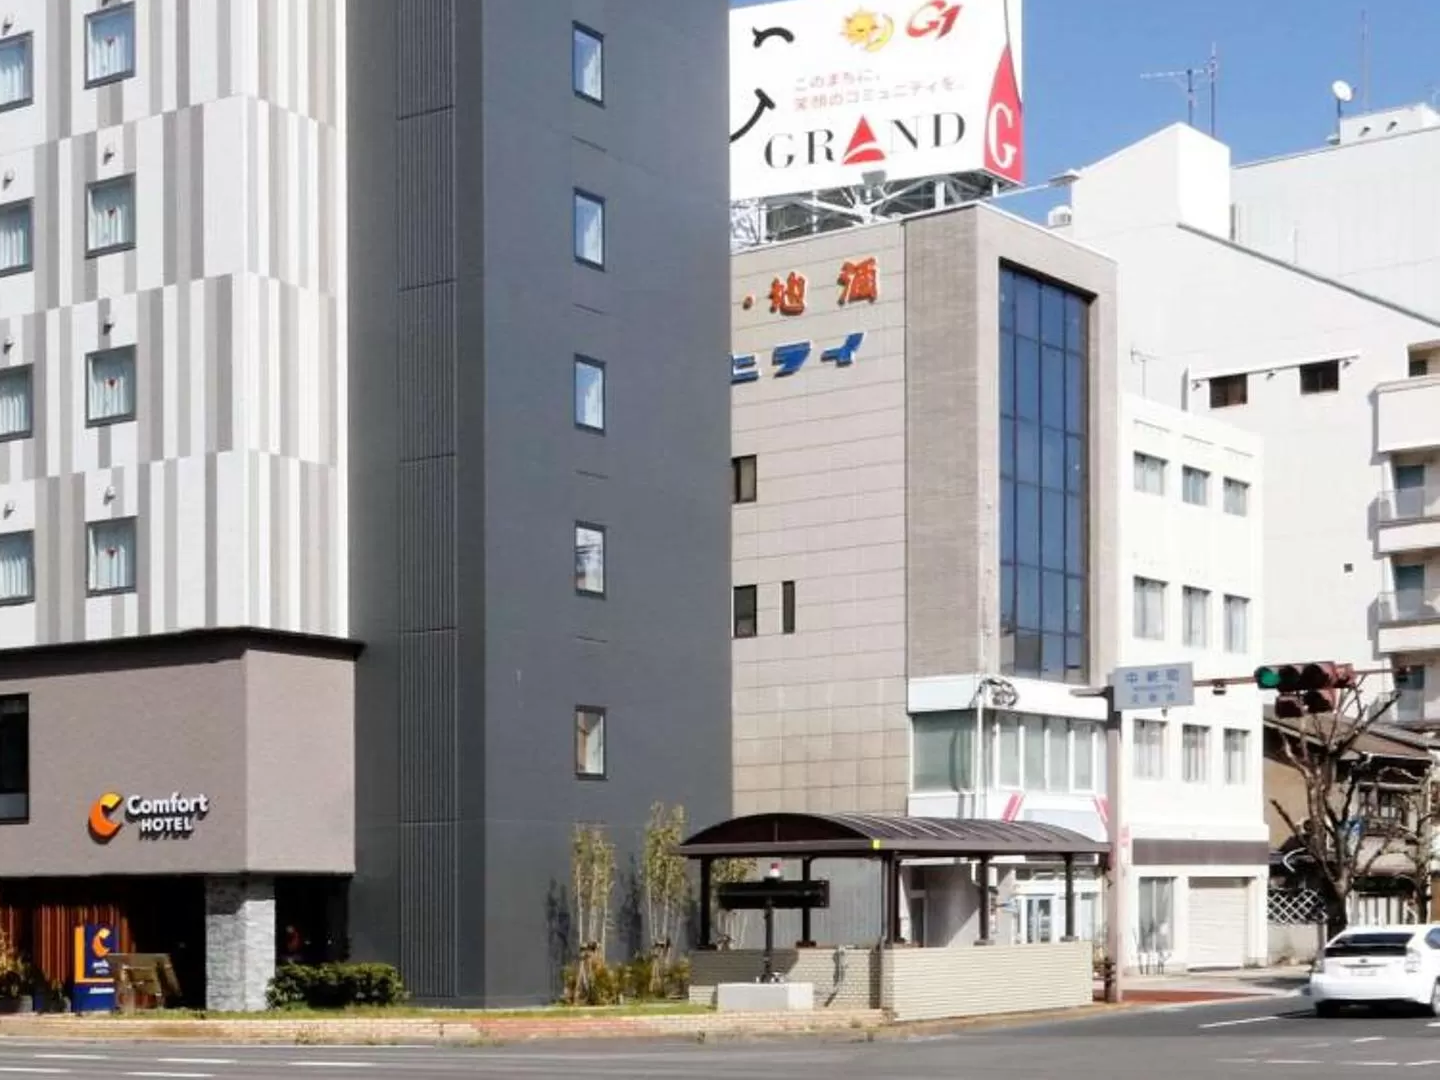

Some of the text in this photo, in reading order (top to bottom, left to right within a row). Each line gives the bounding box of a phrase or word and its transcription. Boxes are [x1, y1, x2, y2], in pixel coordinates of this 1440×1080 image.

[763, 112, 966, 170] GRAND
[126, 791, 210, 815] Comfort
[140, 816, 193, 833] HOTEL
